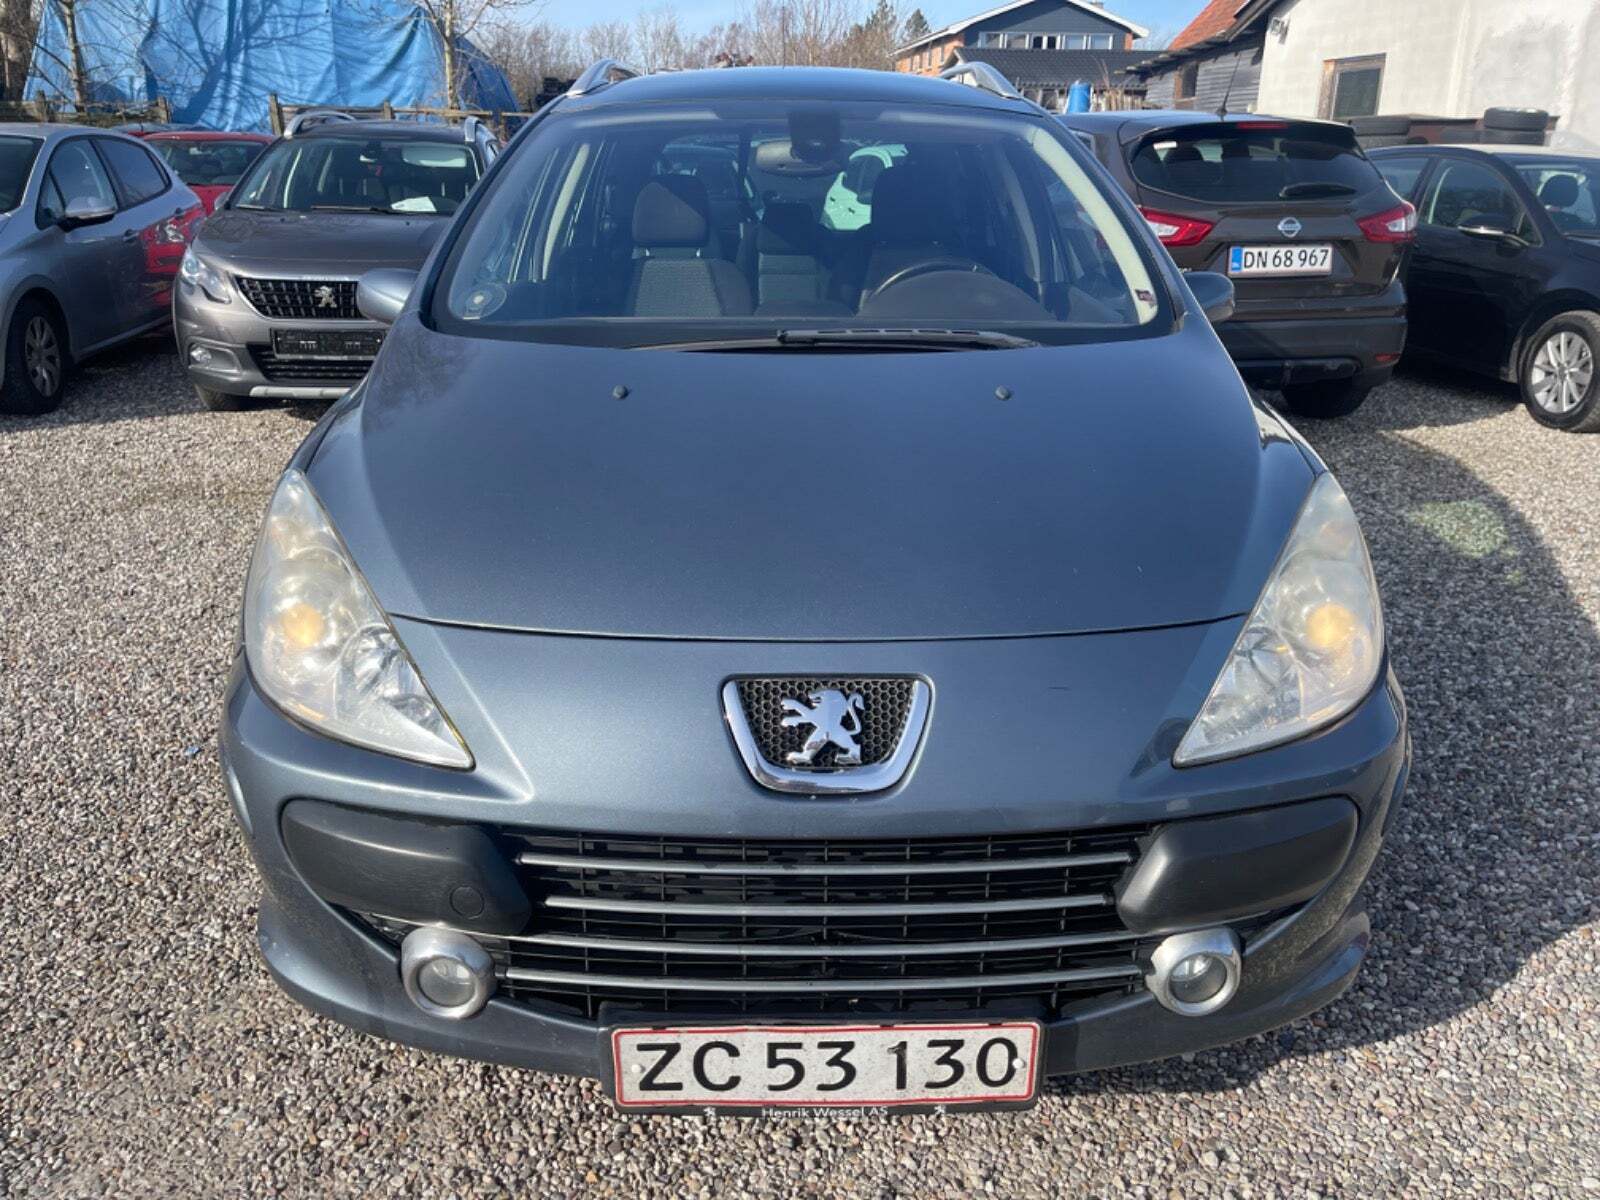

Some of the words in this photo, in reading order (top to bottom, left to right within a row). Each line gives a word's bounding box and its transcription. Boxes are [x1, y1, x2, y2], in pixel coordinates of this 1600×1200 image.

[1244, 251, 1268, 268] DN
[1272, 249, 1293, 268] 68
[1298, 248, 1329, 267] 967
[636, 1040, 741, 1092] ZC
[766, 1041, 857, 1092] 53
[887, 1037, 1018, 1090] 130
[761, 1106, 809, 1118] Henrik
[813, 1106, 865, 1118] Wessel
